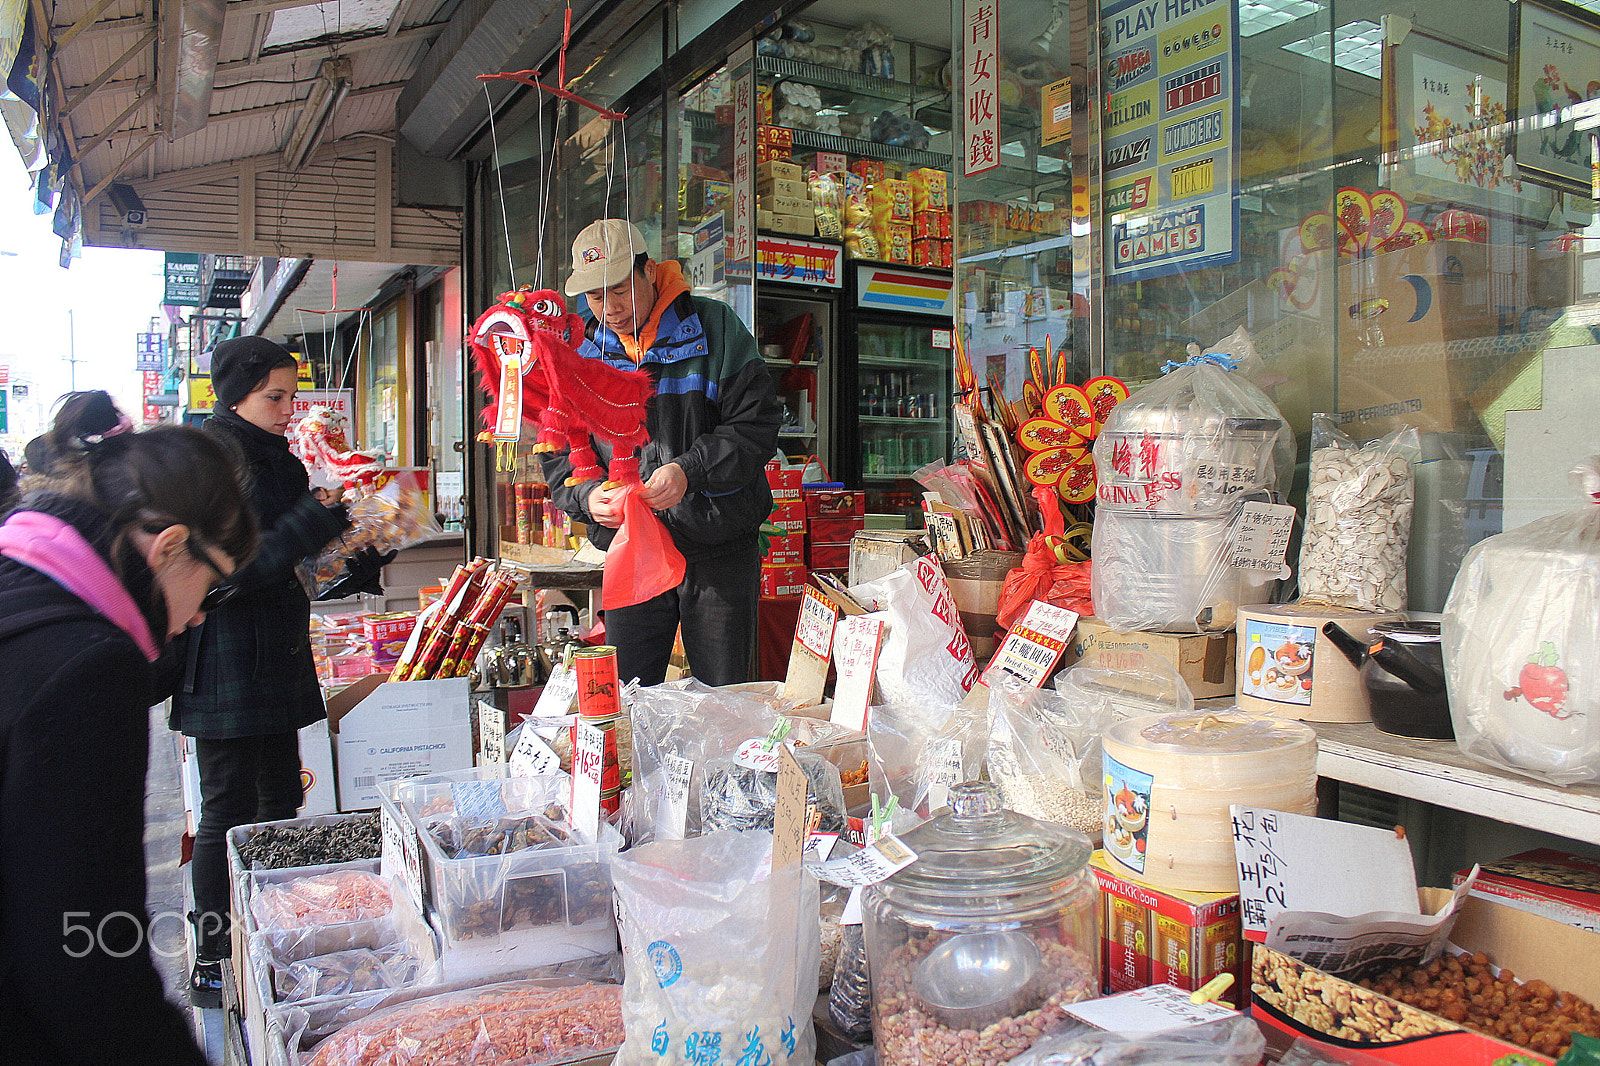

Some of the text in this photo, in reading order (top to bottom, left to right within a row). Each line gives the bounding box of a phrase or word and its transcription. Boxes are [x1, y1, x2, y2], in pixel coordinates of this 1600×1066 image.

[1115, 1, 1159, 44] PLAY
[1163, 29, 1211, 57] POWER
[1114, 62, 1152, 90] MILLIONS
[1117, 50, 1152, 77] MEGA
[1167, 76, 1219, 111] LOTTO
[1103, 100, 1151, 131] MILLION
[1164, 114, 1220, 153] NUMBERS
[1107, 143, 1137, 166] WIN
[1133, 183, 1147, 204] 5
[1174, 169, 1198, 197] PICK
[1120, 228, 1198, 259] GAMES
[1004, 655, 1038, 676] Dried Seeds
[380, 743, 446, 754] CALIFORNIA PISTACHIOS
[1098, 876, 1158, 908] www.LKK.com
[1167, 938, 1178, 987] 鮮味生
